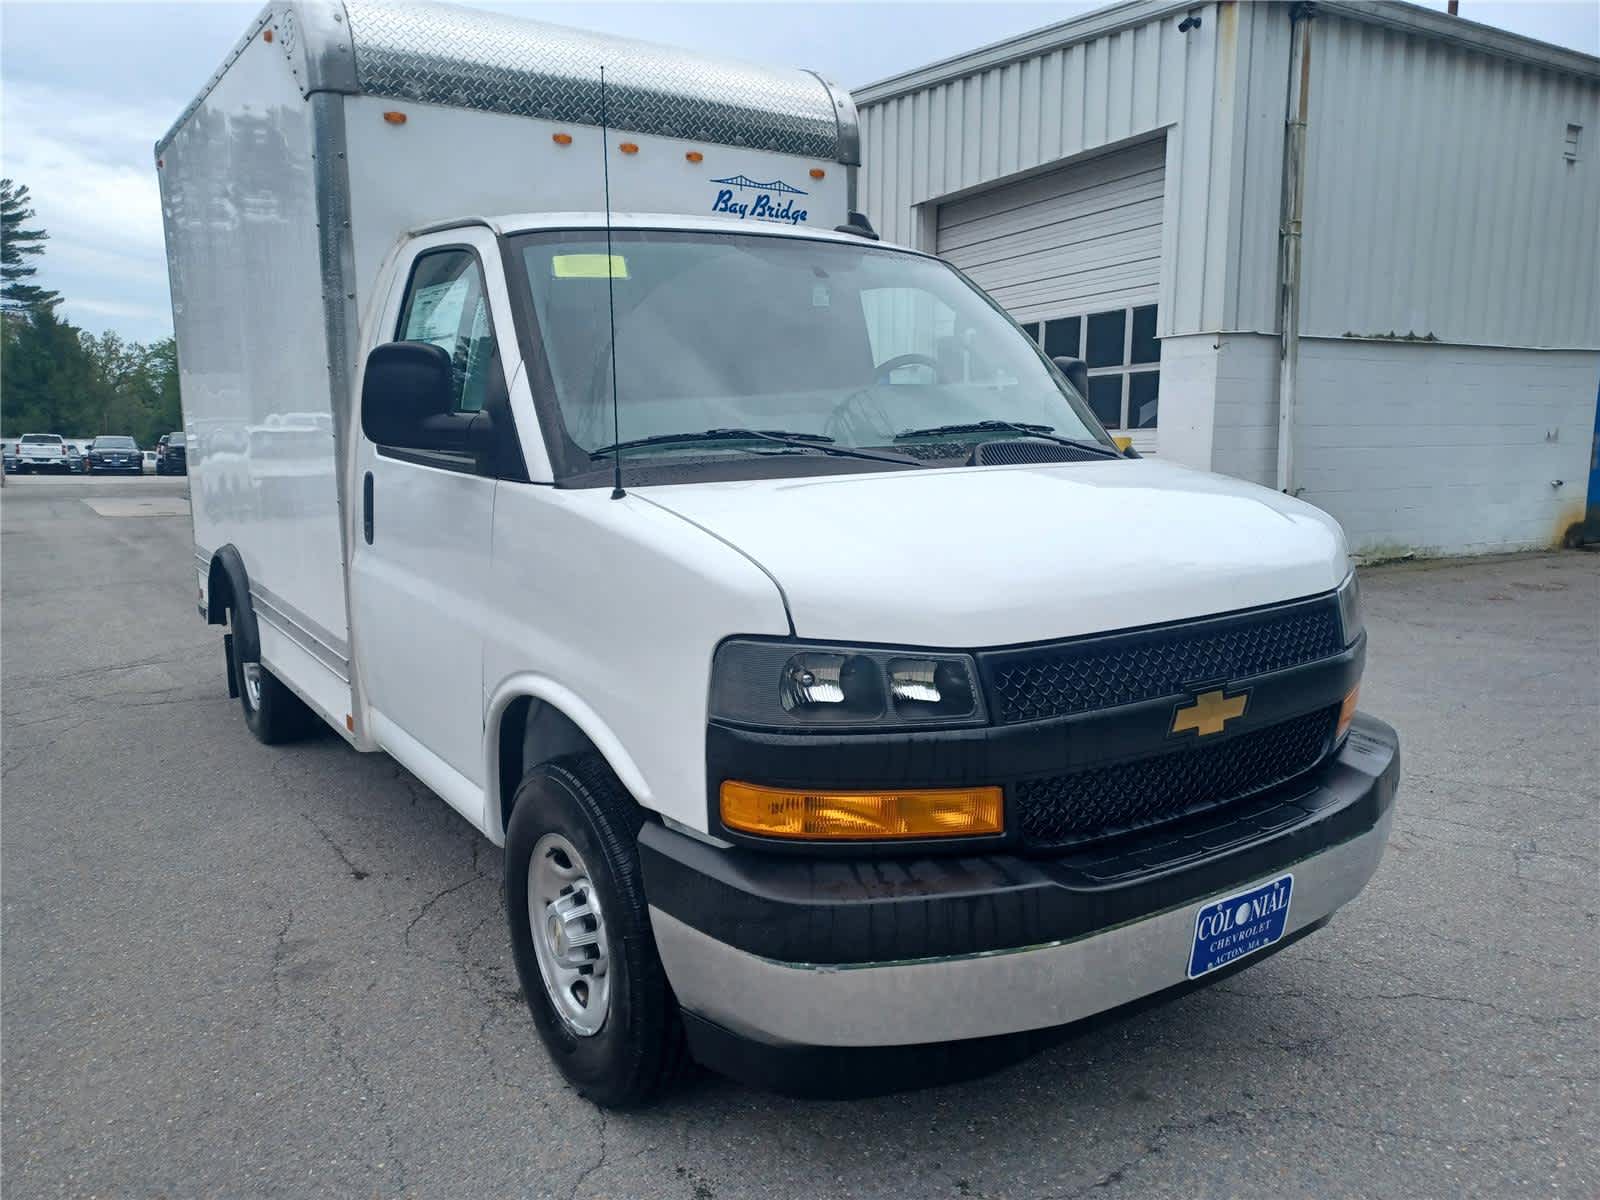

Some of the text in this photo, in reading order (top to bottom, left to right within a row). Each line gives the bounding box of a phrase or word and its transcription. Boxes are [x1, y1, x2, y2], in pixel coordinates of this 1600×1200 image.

[712, 189, 808, 225] Bay Bridge
[1198, 886, 1288, 940] COLONIAL
[1210, 919, 1272, 952] CHEVROLET
